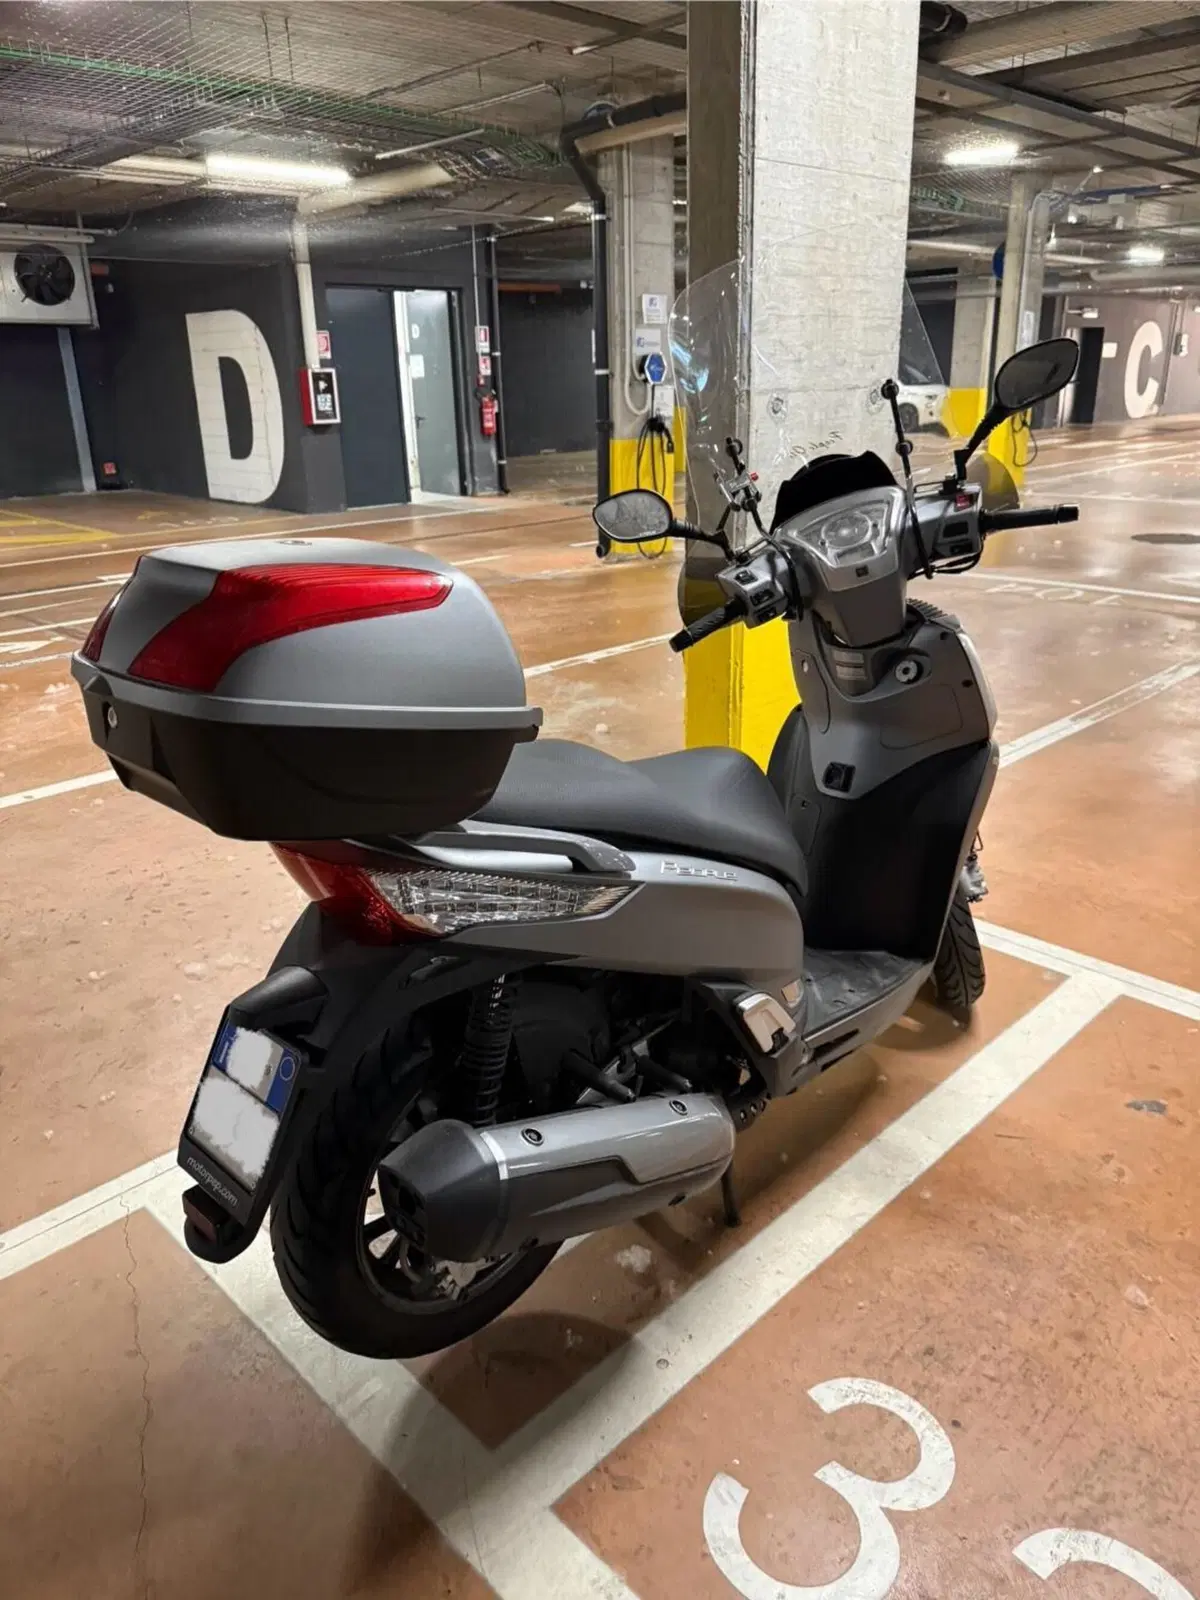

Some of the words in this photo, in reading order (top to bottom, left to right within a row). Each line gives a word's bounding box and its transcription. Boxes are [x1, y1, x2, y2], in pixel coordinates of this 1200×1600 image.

[185, 309, 284, 504] D
[1124, 321, 1163, 419] C
[187, 1156, 239, 1208] motorpep.com
